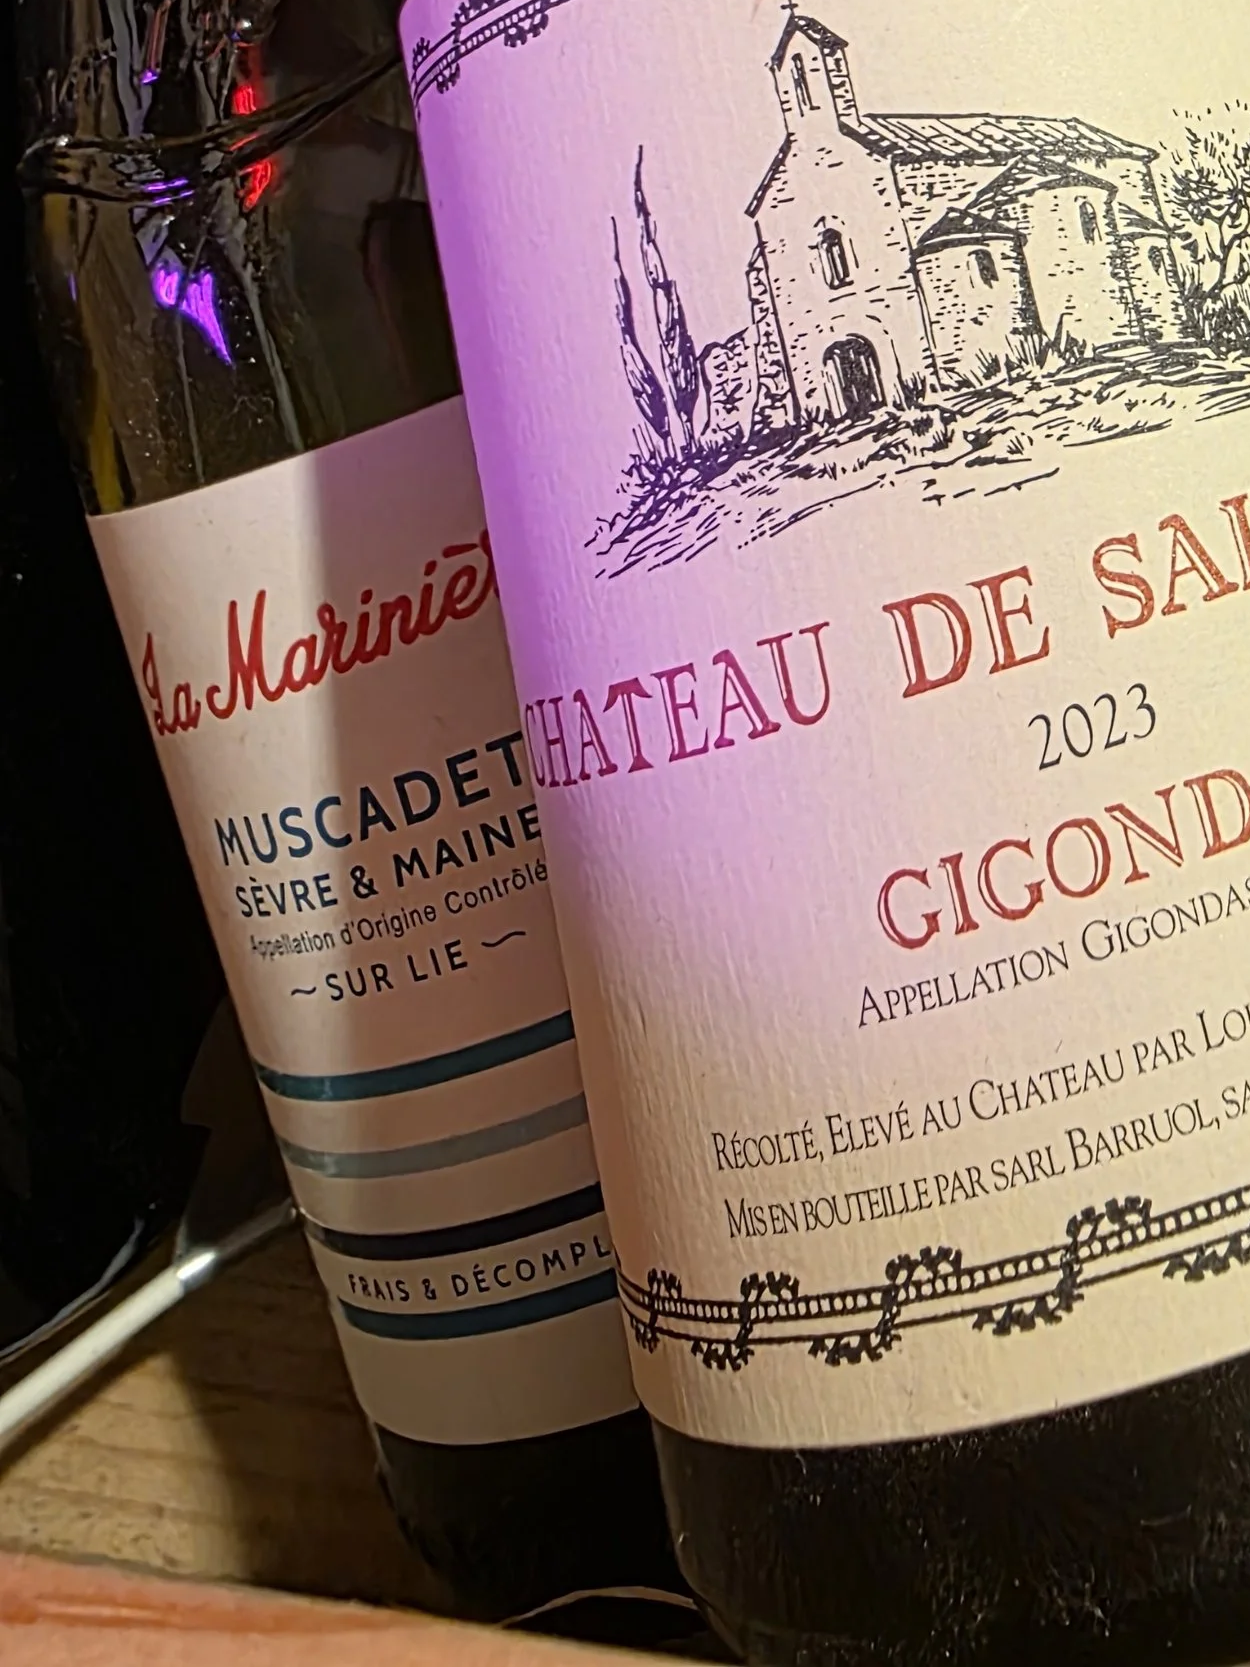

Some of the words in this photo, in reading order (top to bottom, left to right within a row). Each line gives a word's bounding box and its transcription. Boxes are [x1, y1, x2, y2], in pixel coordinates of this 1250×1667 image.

[141, 631, 202, 736] La
[524, 621, 832, 790] CHATEAU
[882, 564, 1051, 698] DE
[1027, 683, 1159, 771] 2023
[213, 730, 527, 867] MUSCADET
[235, 873, 339, 920] SÈVRE
[350, 864, 379, 900] &
[391, 802, 543, 888] MAINE
[249, 929, 336, 963] Appellation
[339, 903, 438, 946] d'Origine
[324, 963, 395, 1002] SUR
[407, 939, 469, 983] LIE
[857, 941, 1071, 1029] APPELLATION
[826, 1101, 914, 1155] ELEVÉ
[921, 1096, 962, 1136] AU
[968, 1048, 1126, 1121] CHATEAU
[1131, 1028, 1196, 1076] PAR
[723, 1197, 767, 1239] MIS
[770, 1202, 800, 1235] EN
[801, 1177, 935, 1232] BOUTEILLE
[936, 1165, 990, 1206] PAR
[990, 1144, 1067, 1192] SARL
[1066, 1098, 1221, 1171] BARRUOL,
[347, 1273, 411, 1303] FRAIS
[422, 1277, 438, 1300] &
[449, 1234, 613, 1298] DÉCOMPL
